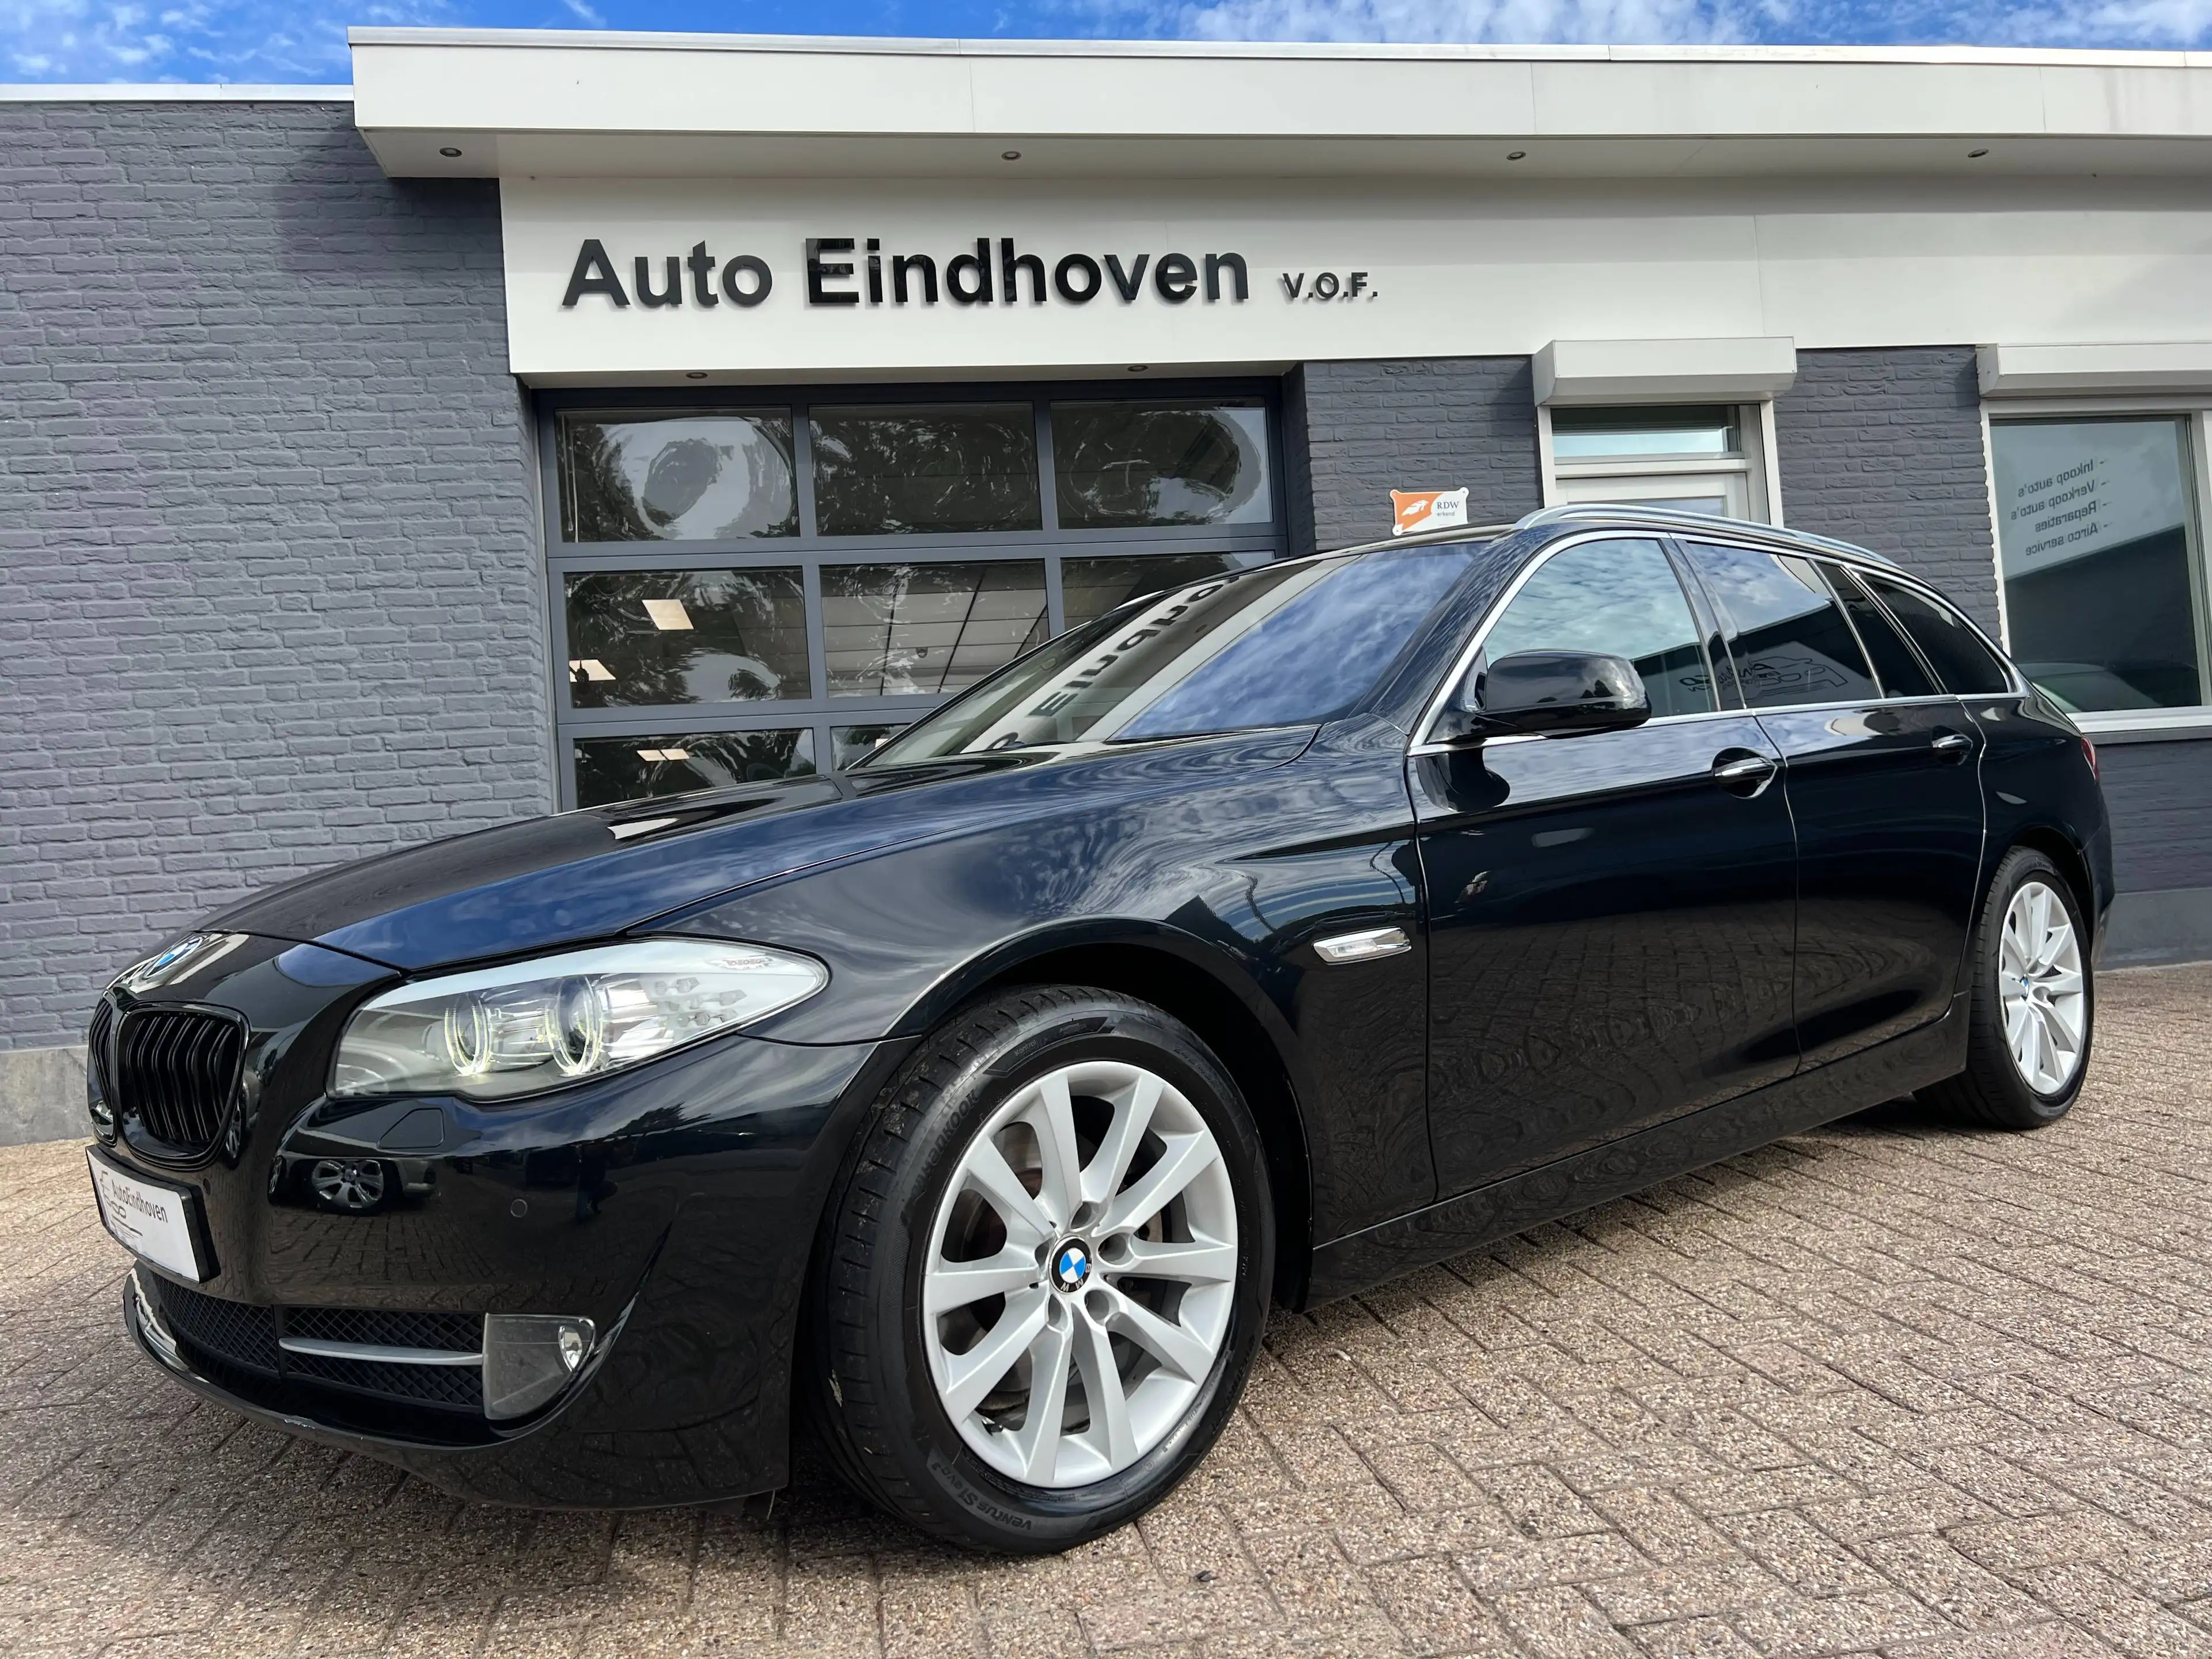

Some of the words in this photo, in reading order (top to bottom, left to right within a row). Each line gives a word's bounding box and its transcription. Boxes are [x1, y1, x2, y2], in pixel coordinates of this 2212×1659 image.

[563, 240, 772, 306] Auto
[806, 238, 1248, 305] Eindhoven
[1437, 501, 1459, 509] RDW
[112, 1179, 168, 1223] AutoEindhoven
